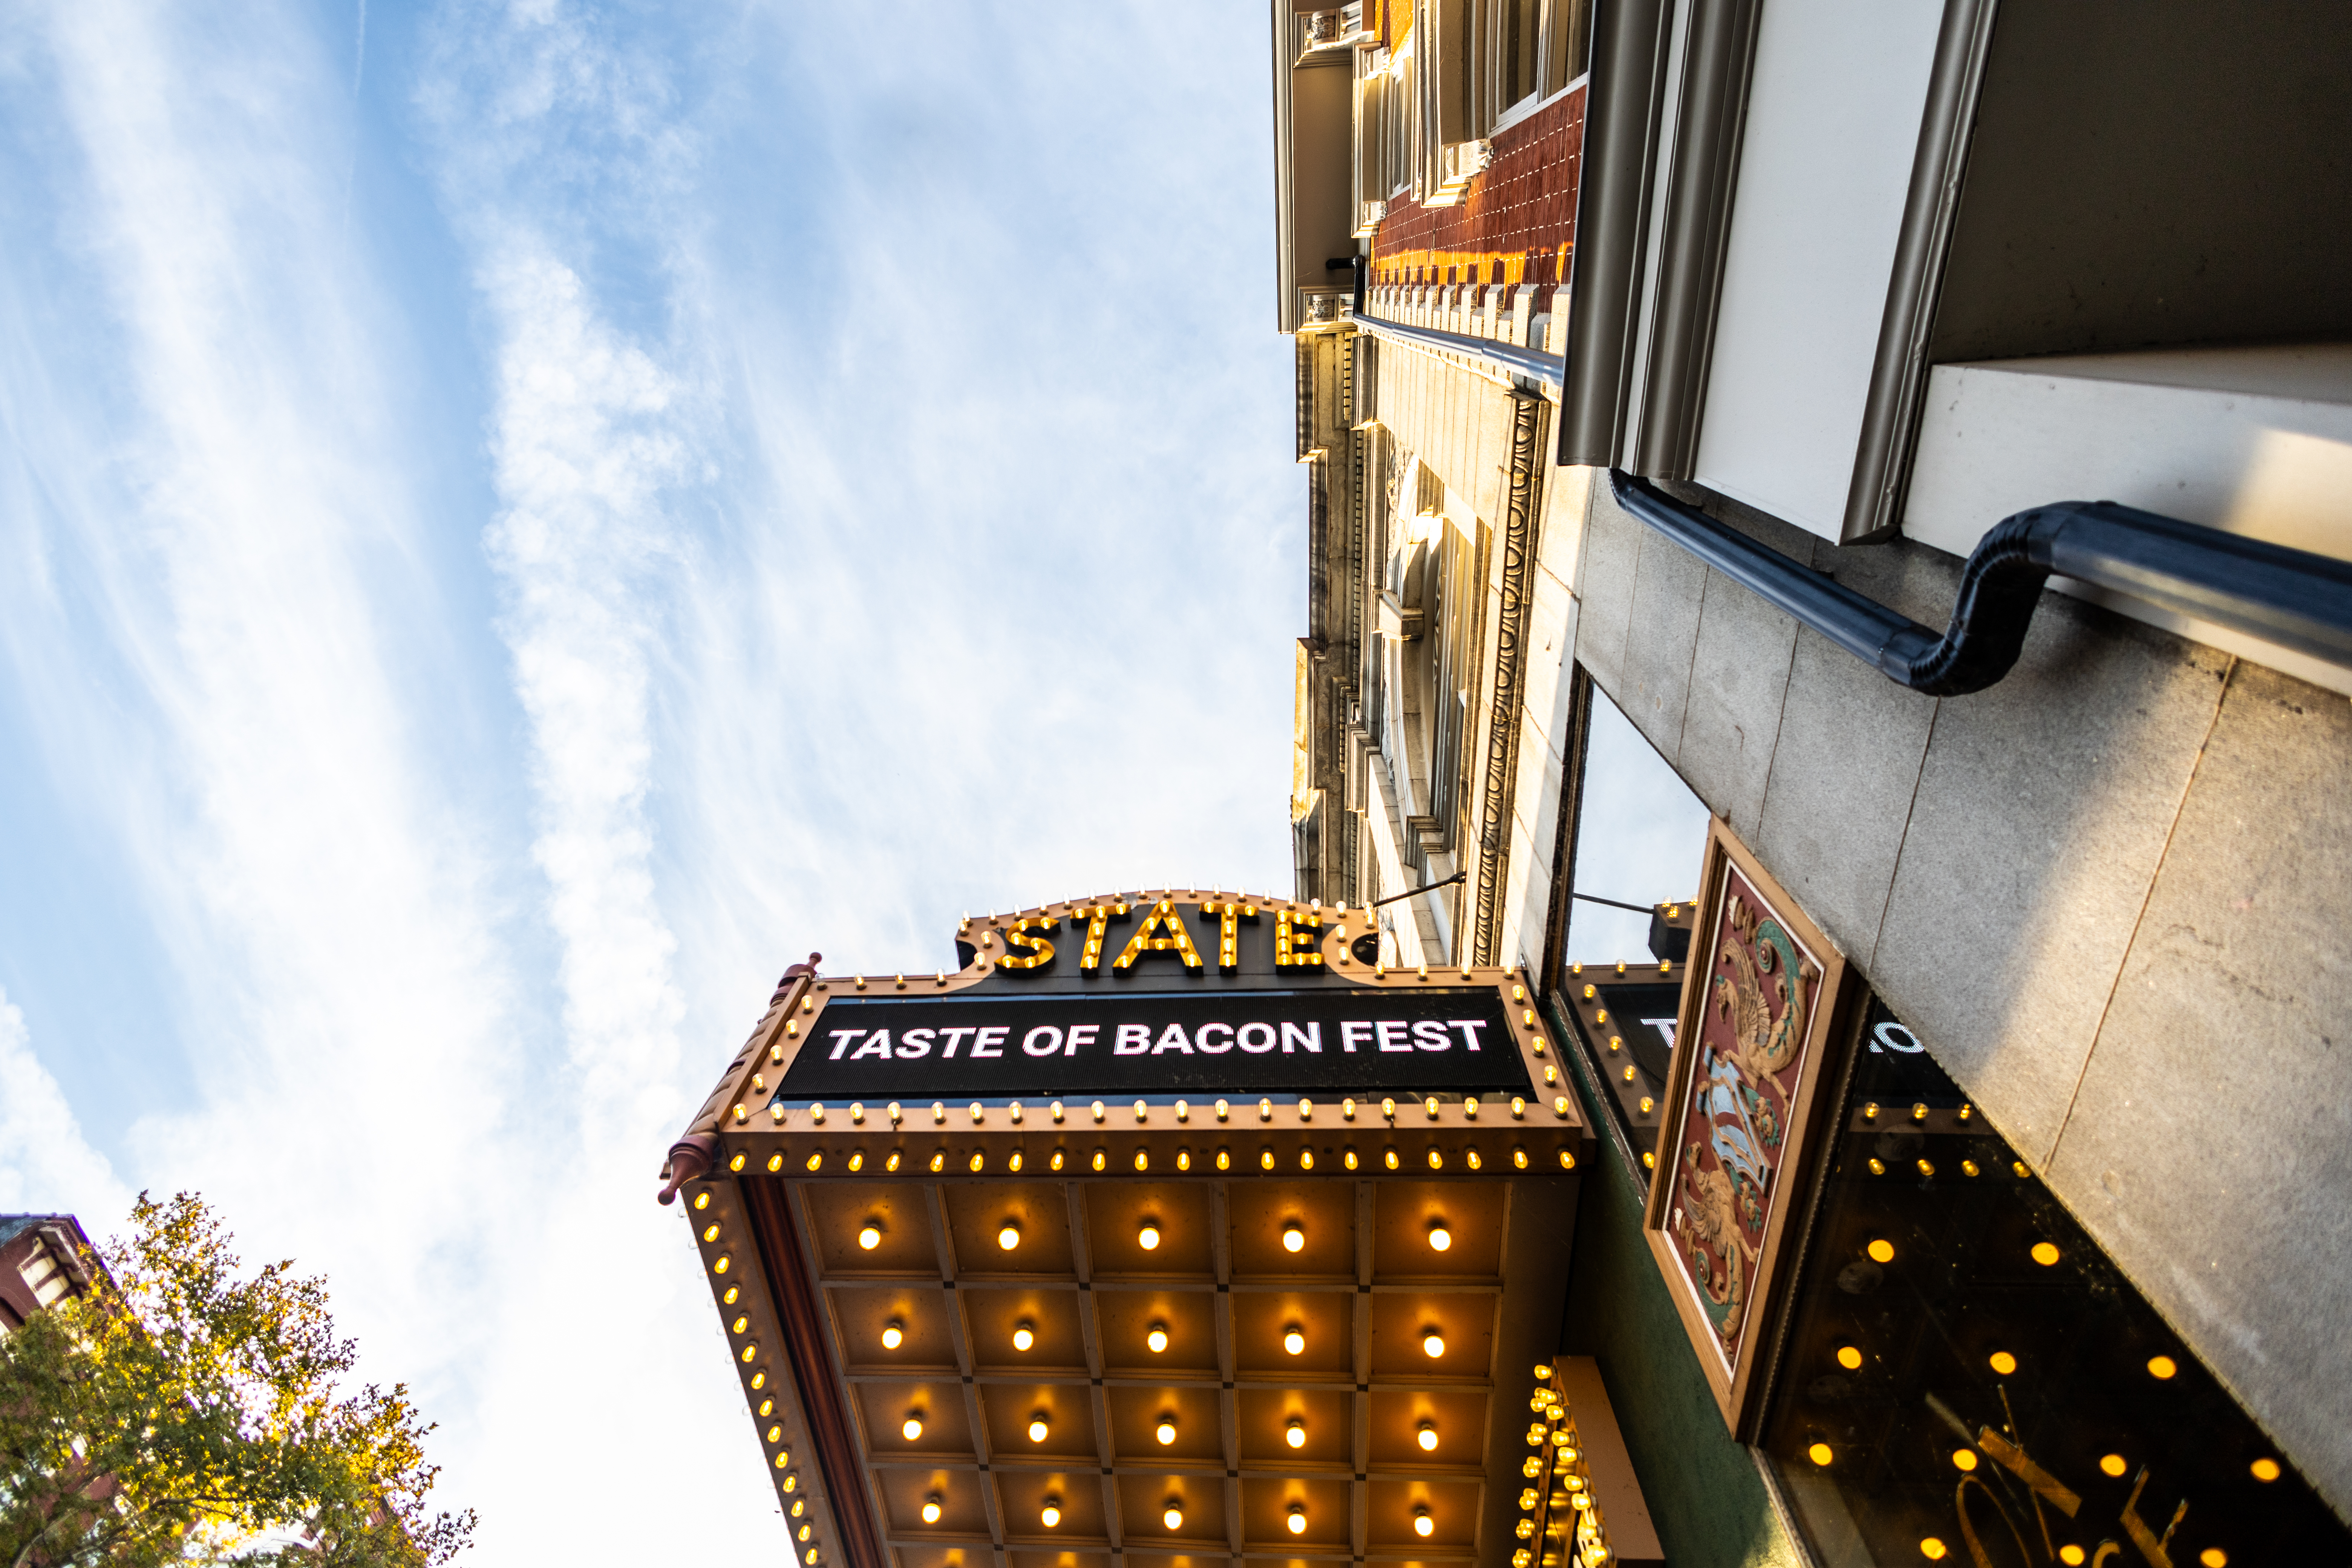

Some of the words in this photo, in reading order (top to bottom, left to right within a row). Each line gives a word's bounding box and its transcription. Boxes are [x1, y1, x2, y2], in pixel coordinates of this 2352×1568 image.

[994, 899, 1325, 977] STATE
[828, 1027, 1011, 1060] TASTE
[1022, 1025, 1100, 1056] OF
[1113, 1021, 1323, 1055] BACON
[1340, 1020, 1487, 1053] FEST
